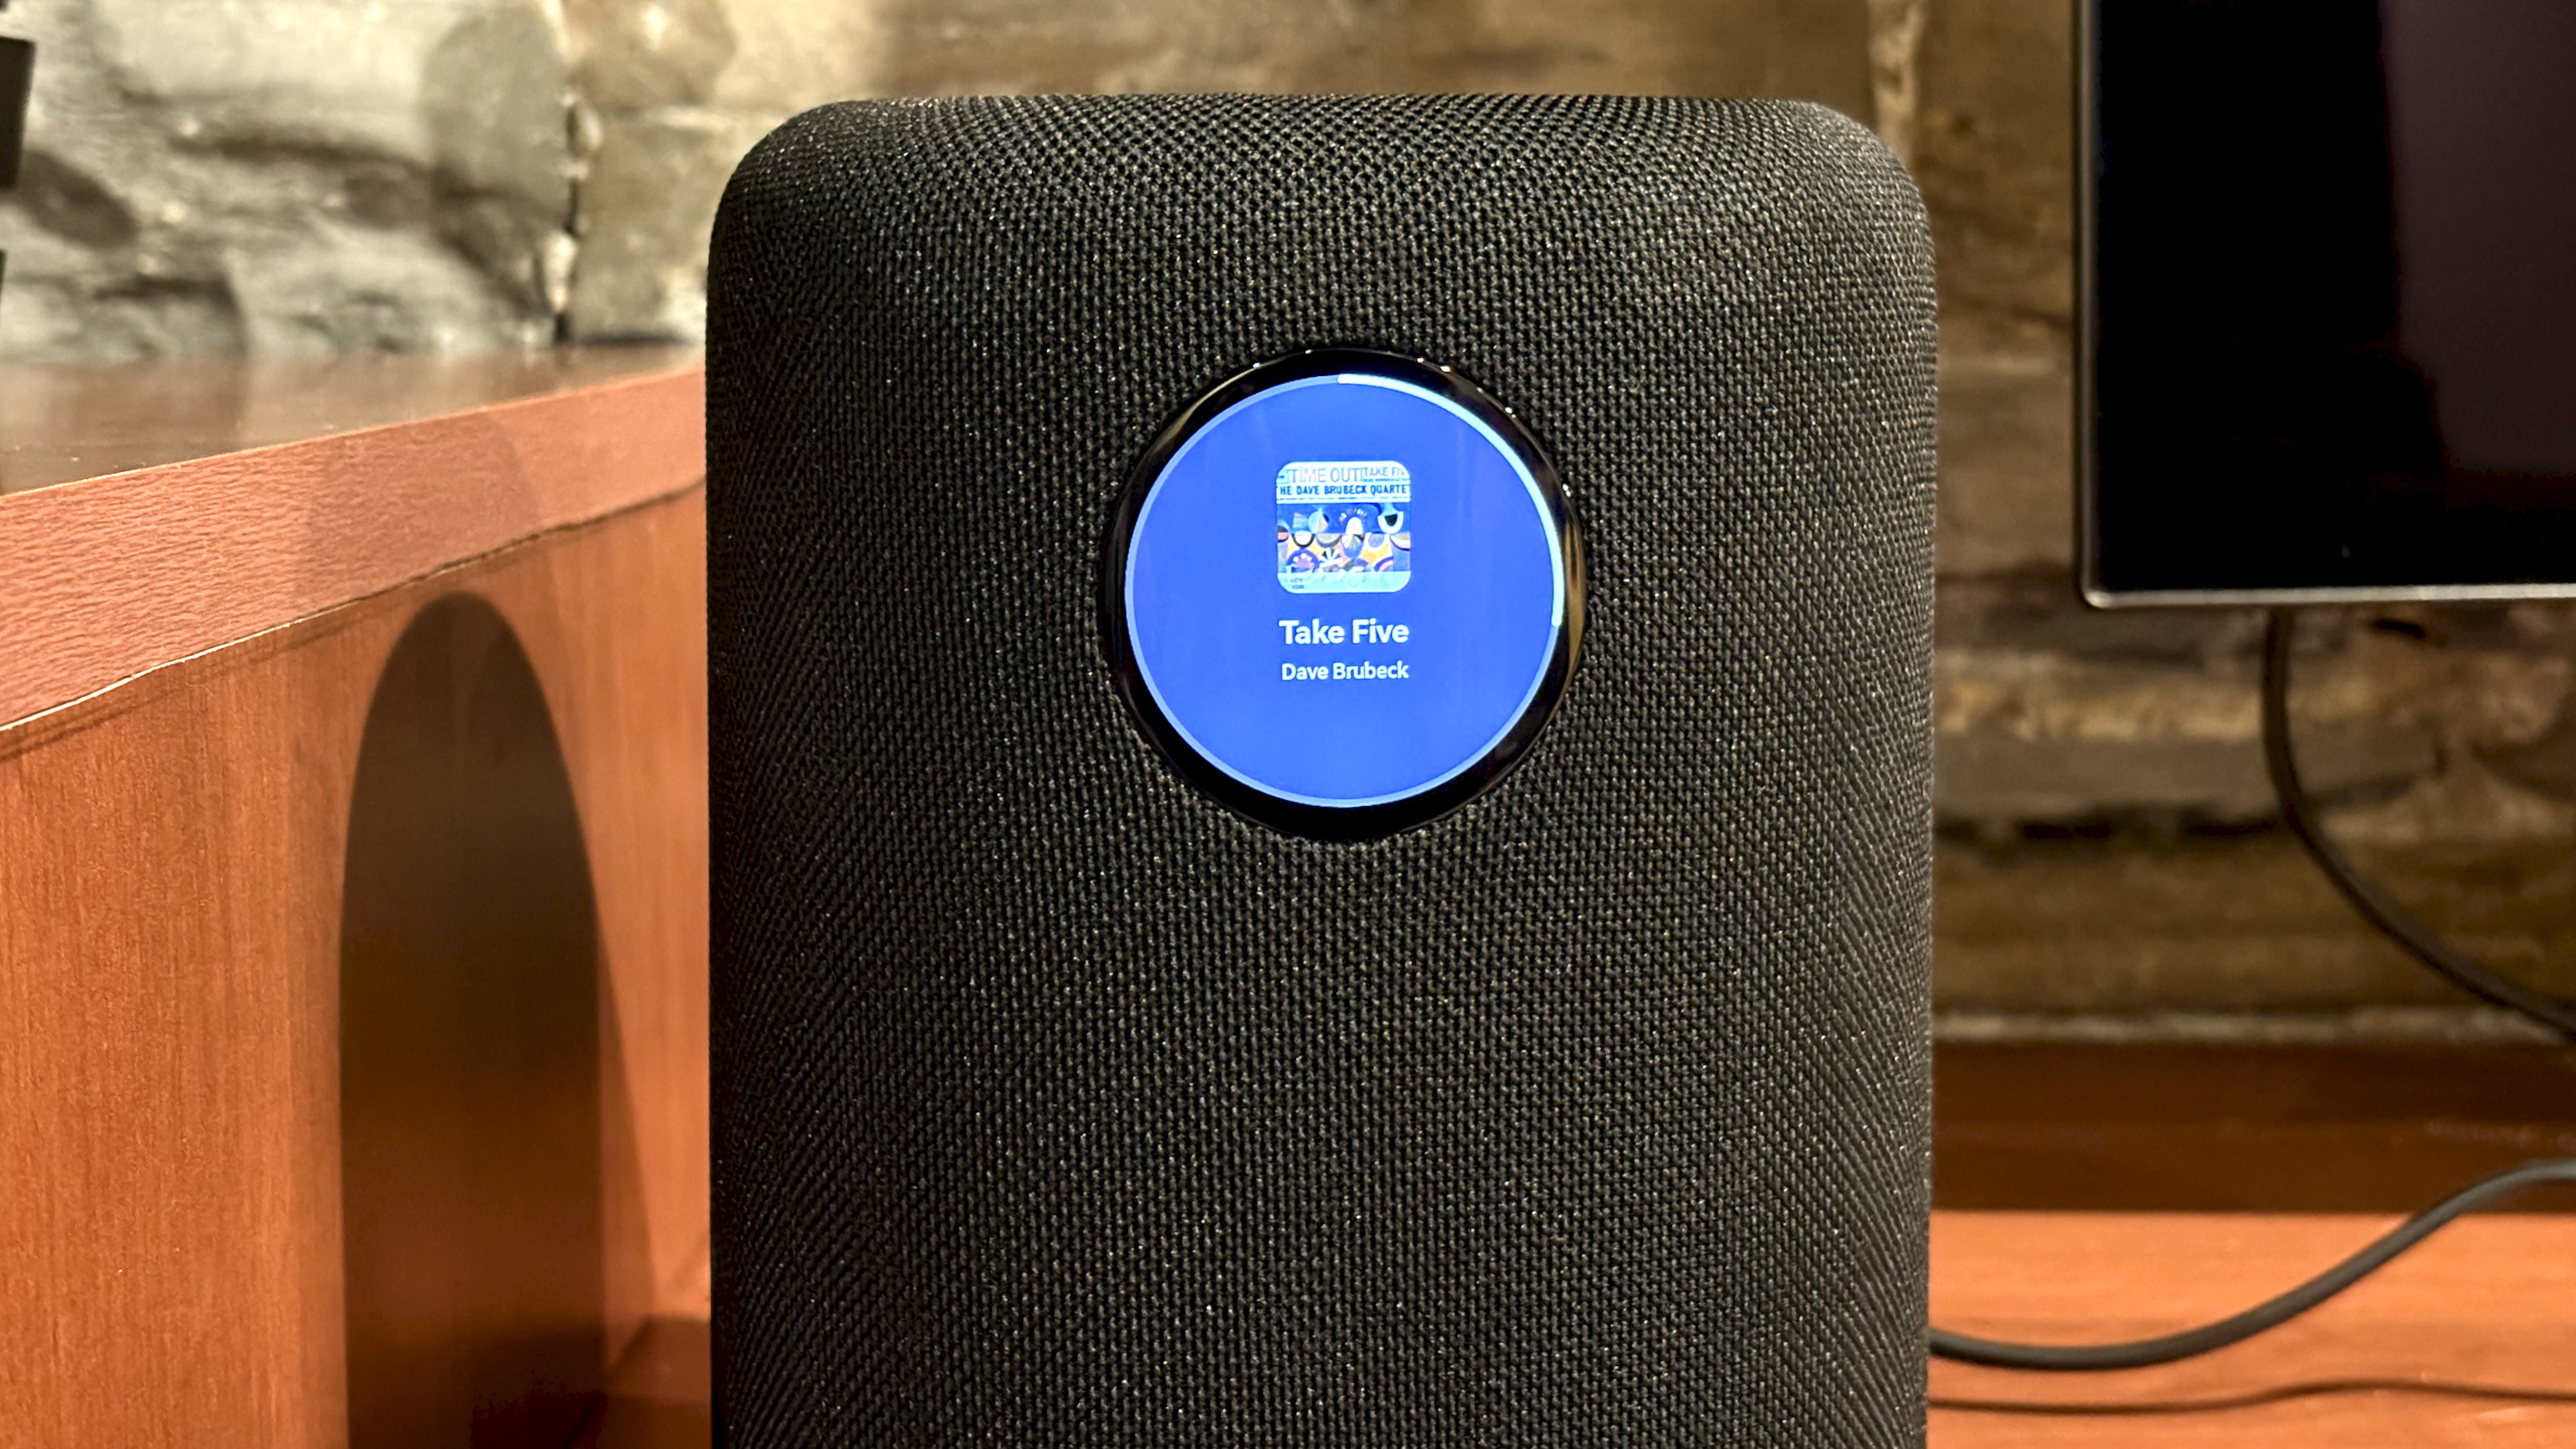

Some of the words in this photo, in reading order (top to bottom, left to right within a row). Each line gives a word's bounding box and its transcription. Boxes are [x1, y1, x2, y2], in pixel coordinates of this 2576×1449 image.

[1289, 468, 1327, 483] TIME
[1330, 467, 1361, 483] OUT
[1391, 466, 1406, 477] FIV
[1279, 484, 1292, 495] HE
[1297, 484, 1320, 495] DAVE
[1324, 484, 1368, 495] BRUBECK
[1370, 483, 1407, 496] QUARTE
[1278, 618, 1346, 645] Take
[1352, 617, 1410, 644] Five
[1281, 663, 1329, 681] Dave
[1333, 660, 1410, 680] Brubeck
